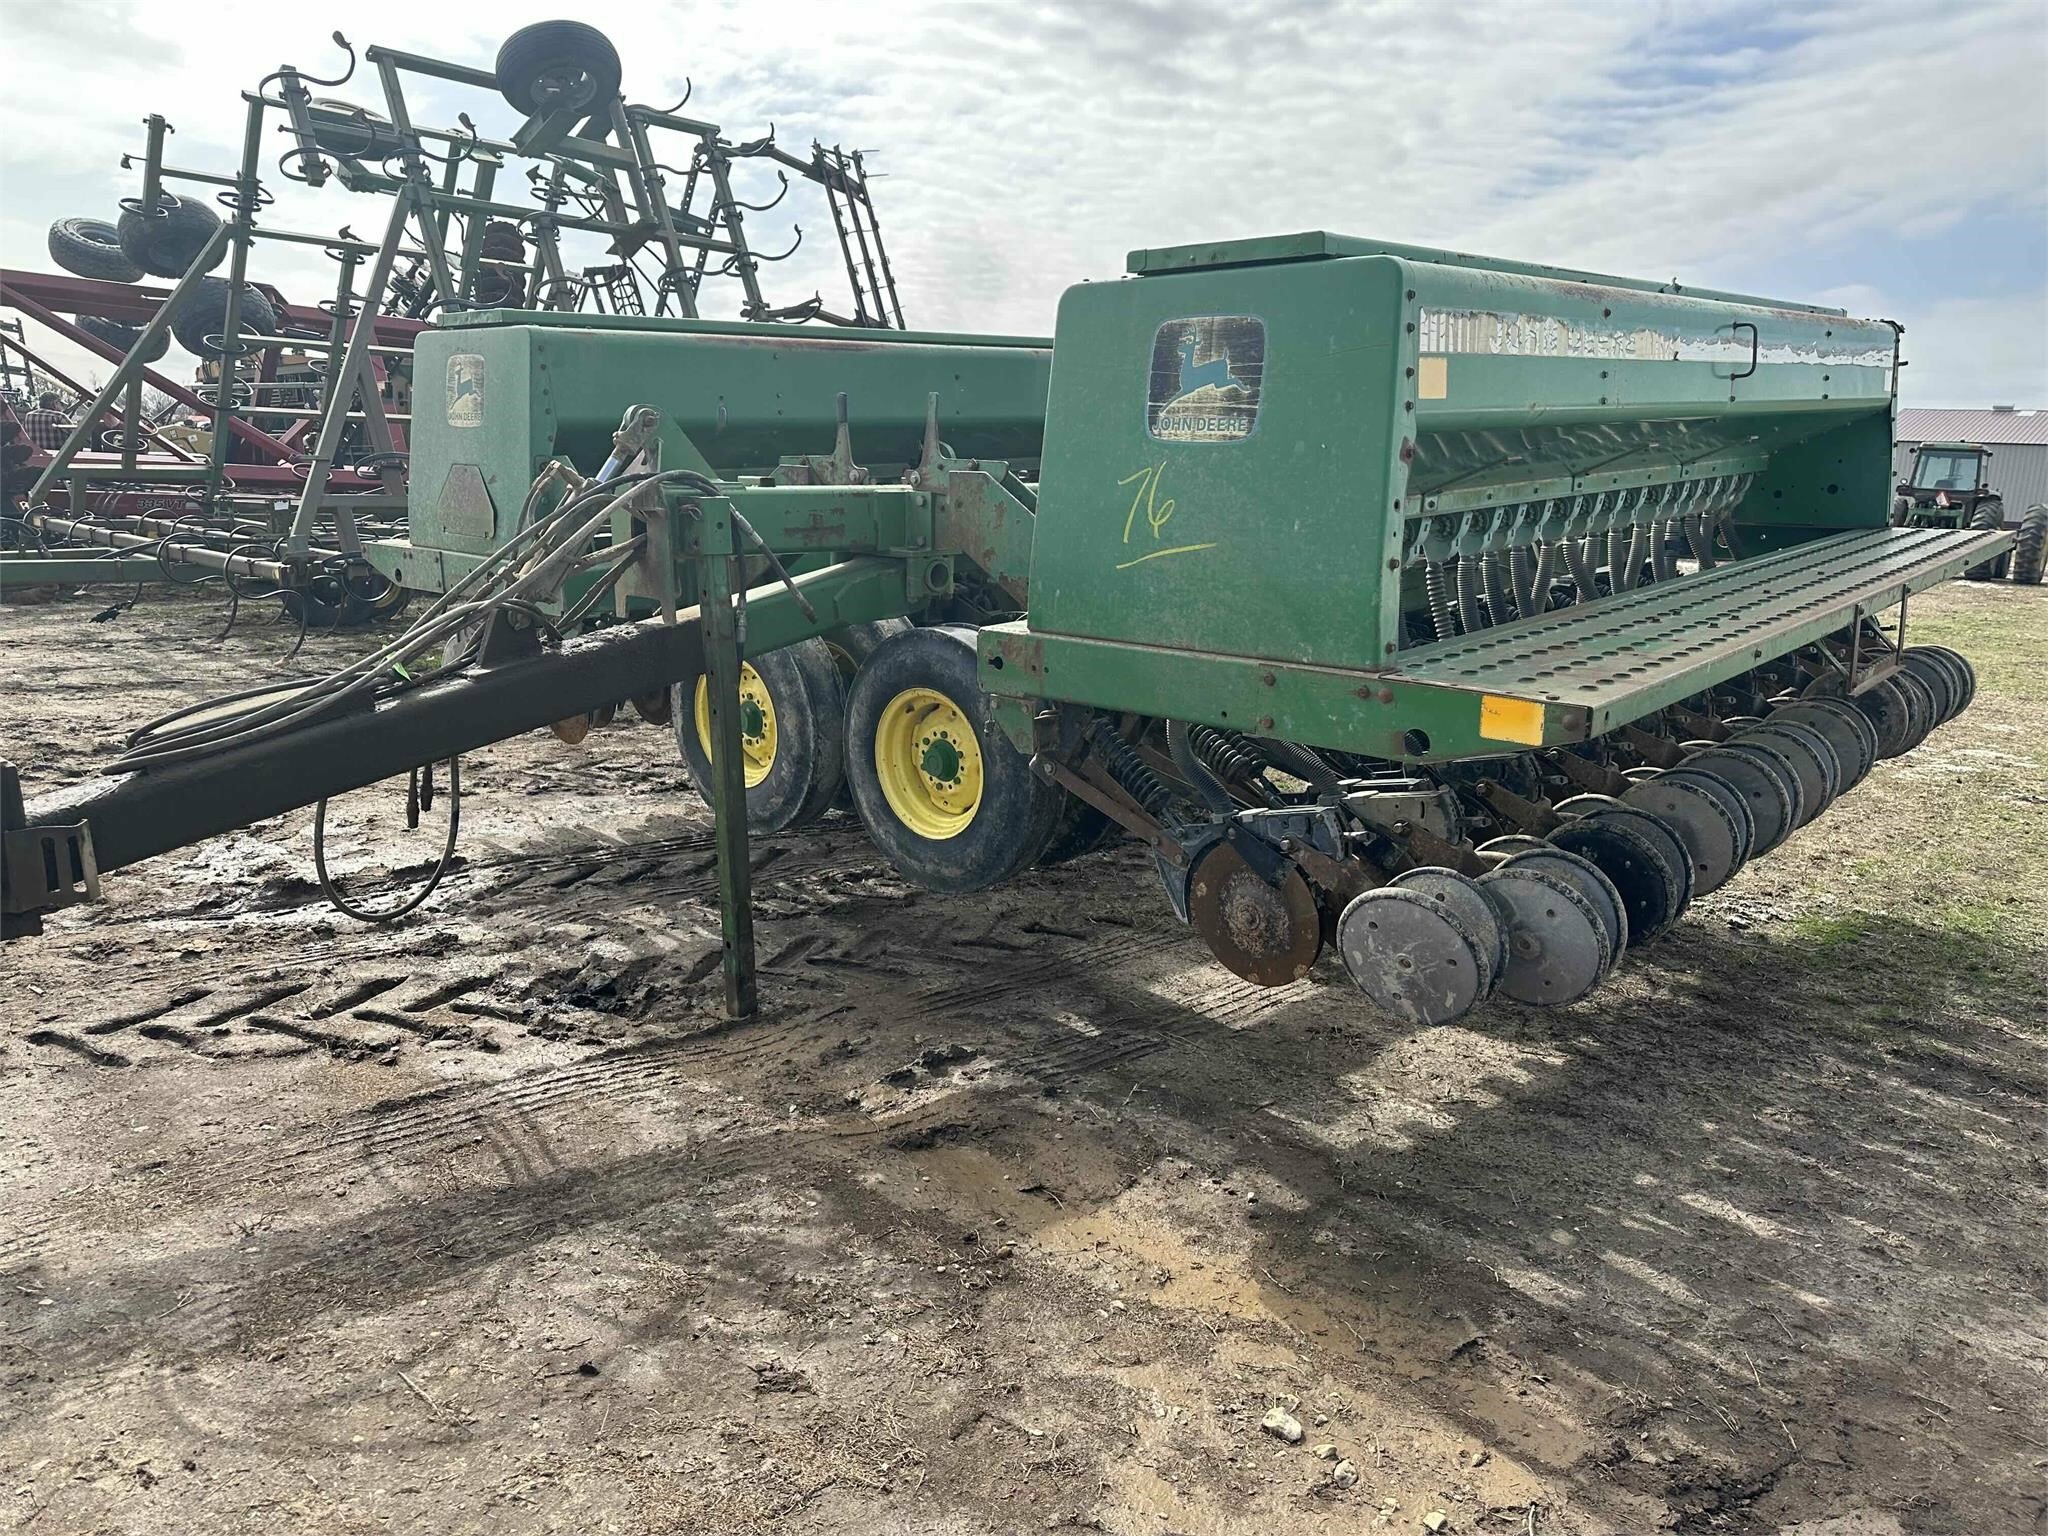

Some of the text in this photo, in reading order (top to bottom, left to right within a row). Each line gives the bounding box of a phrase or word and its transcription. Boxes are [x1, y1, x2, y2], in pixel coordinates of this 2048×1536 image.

[1152, 416, 1249, 434] JOHN DEERE
[1117, 460, 1176, 544] 76
